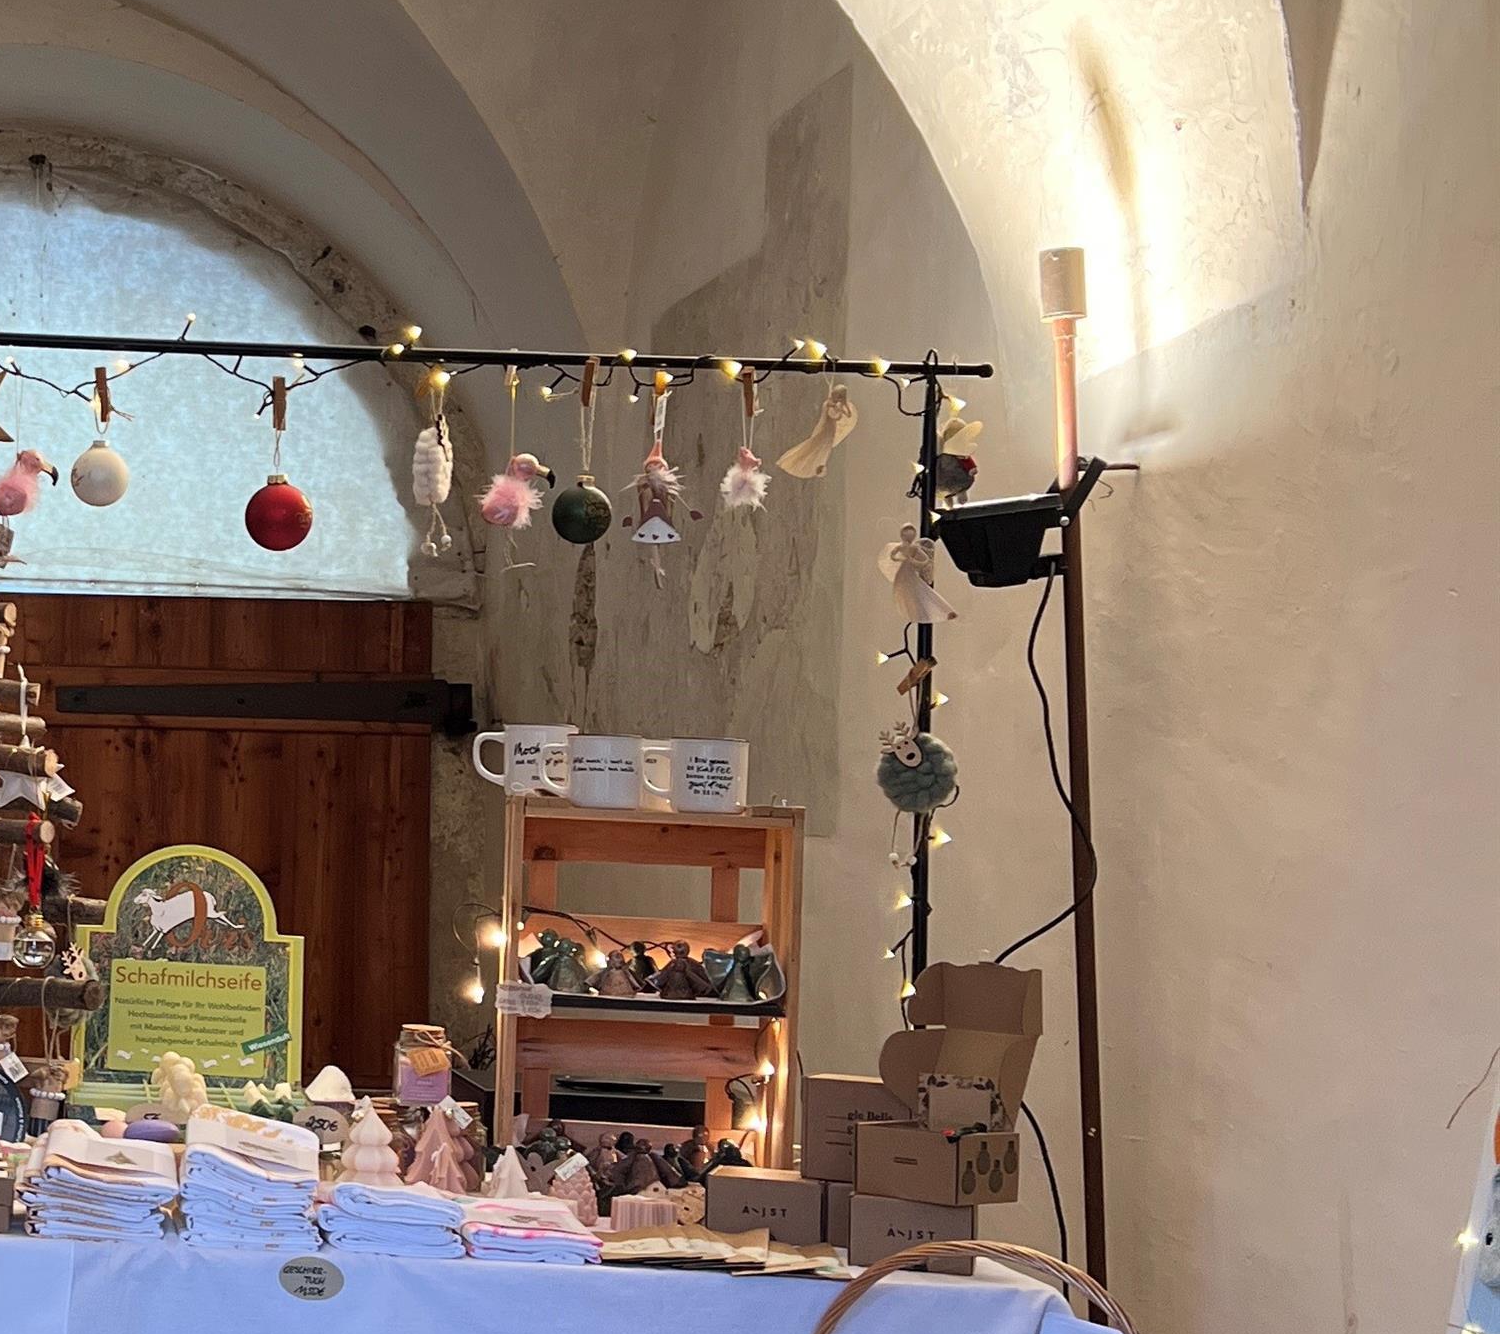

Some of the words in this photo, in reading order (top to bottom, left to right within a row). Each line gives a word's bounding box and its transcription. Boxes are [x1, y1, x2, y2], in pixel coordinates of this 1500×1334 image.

[115, 966, 263, 991] Schafmilchseife
[156, 999, 181, 1008] Pflege
[182, 1000, 193, 1008] für
[208, 1002, 262, 1012] Wohlbefinden
[229, 1028, 244, 1036] und
